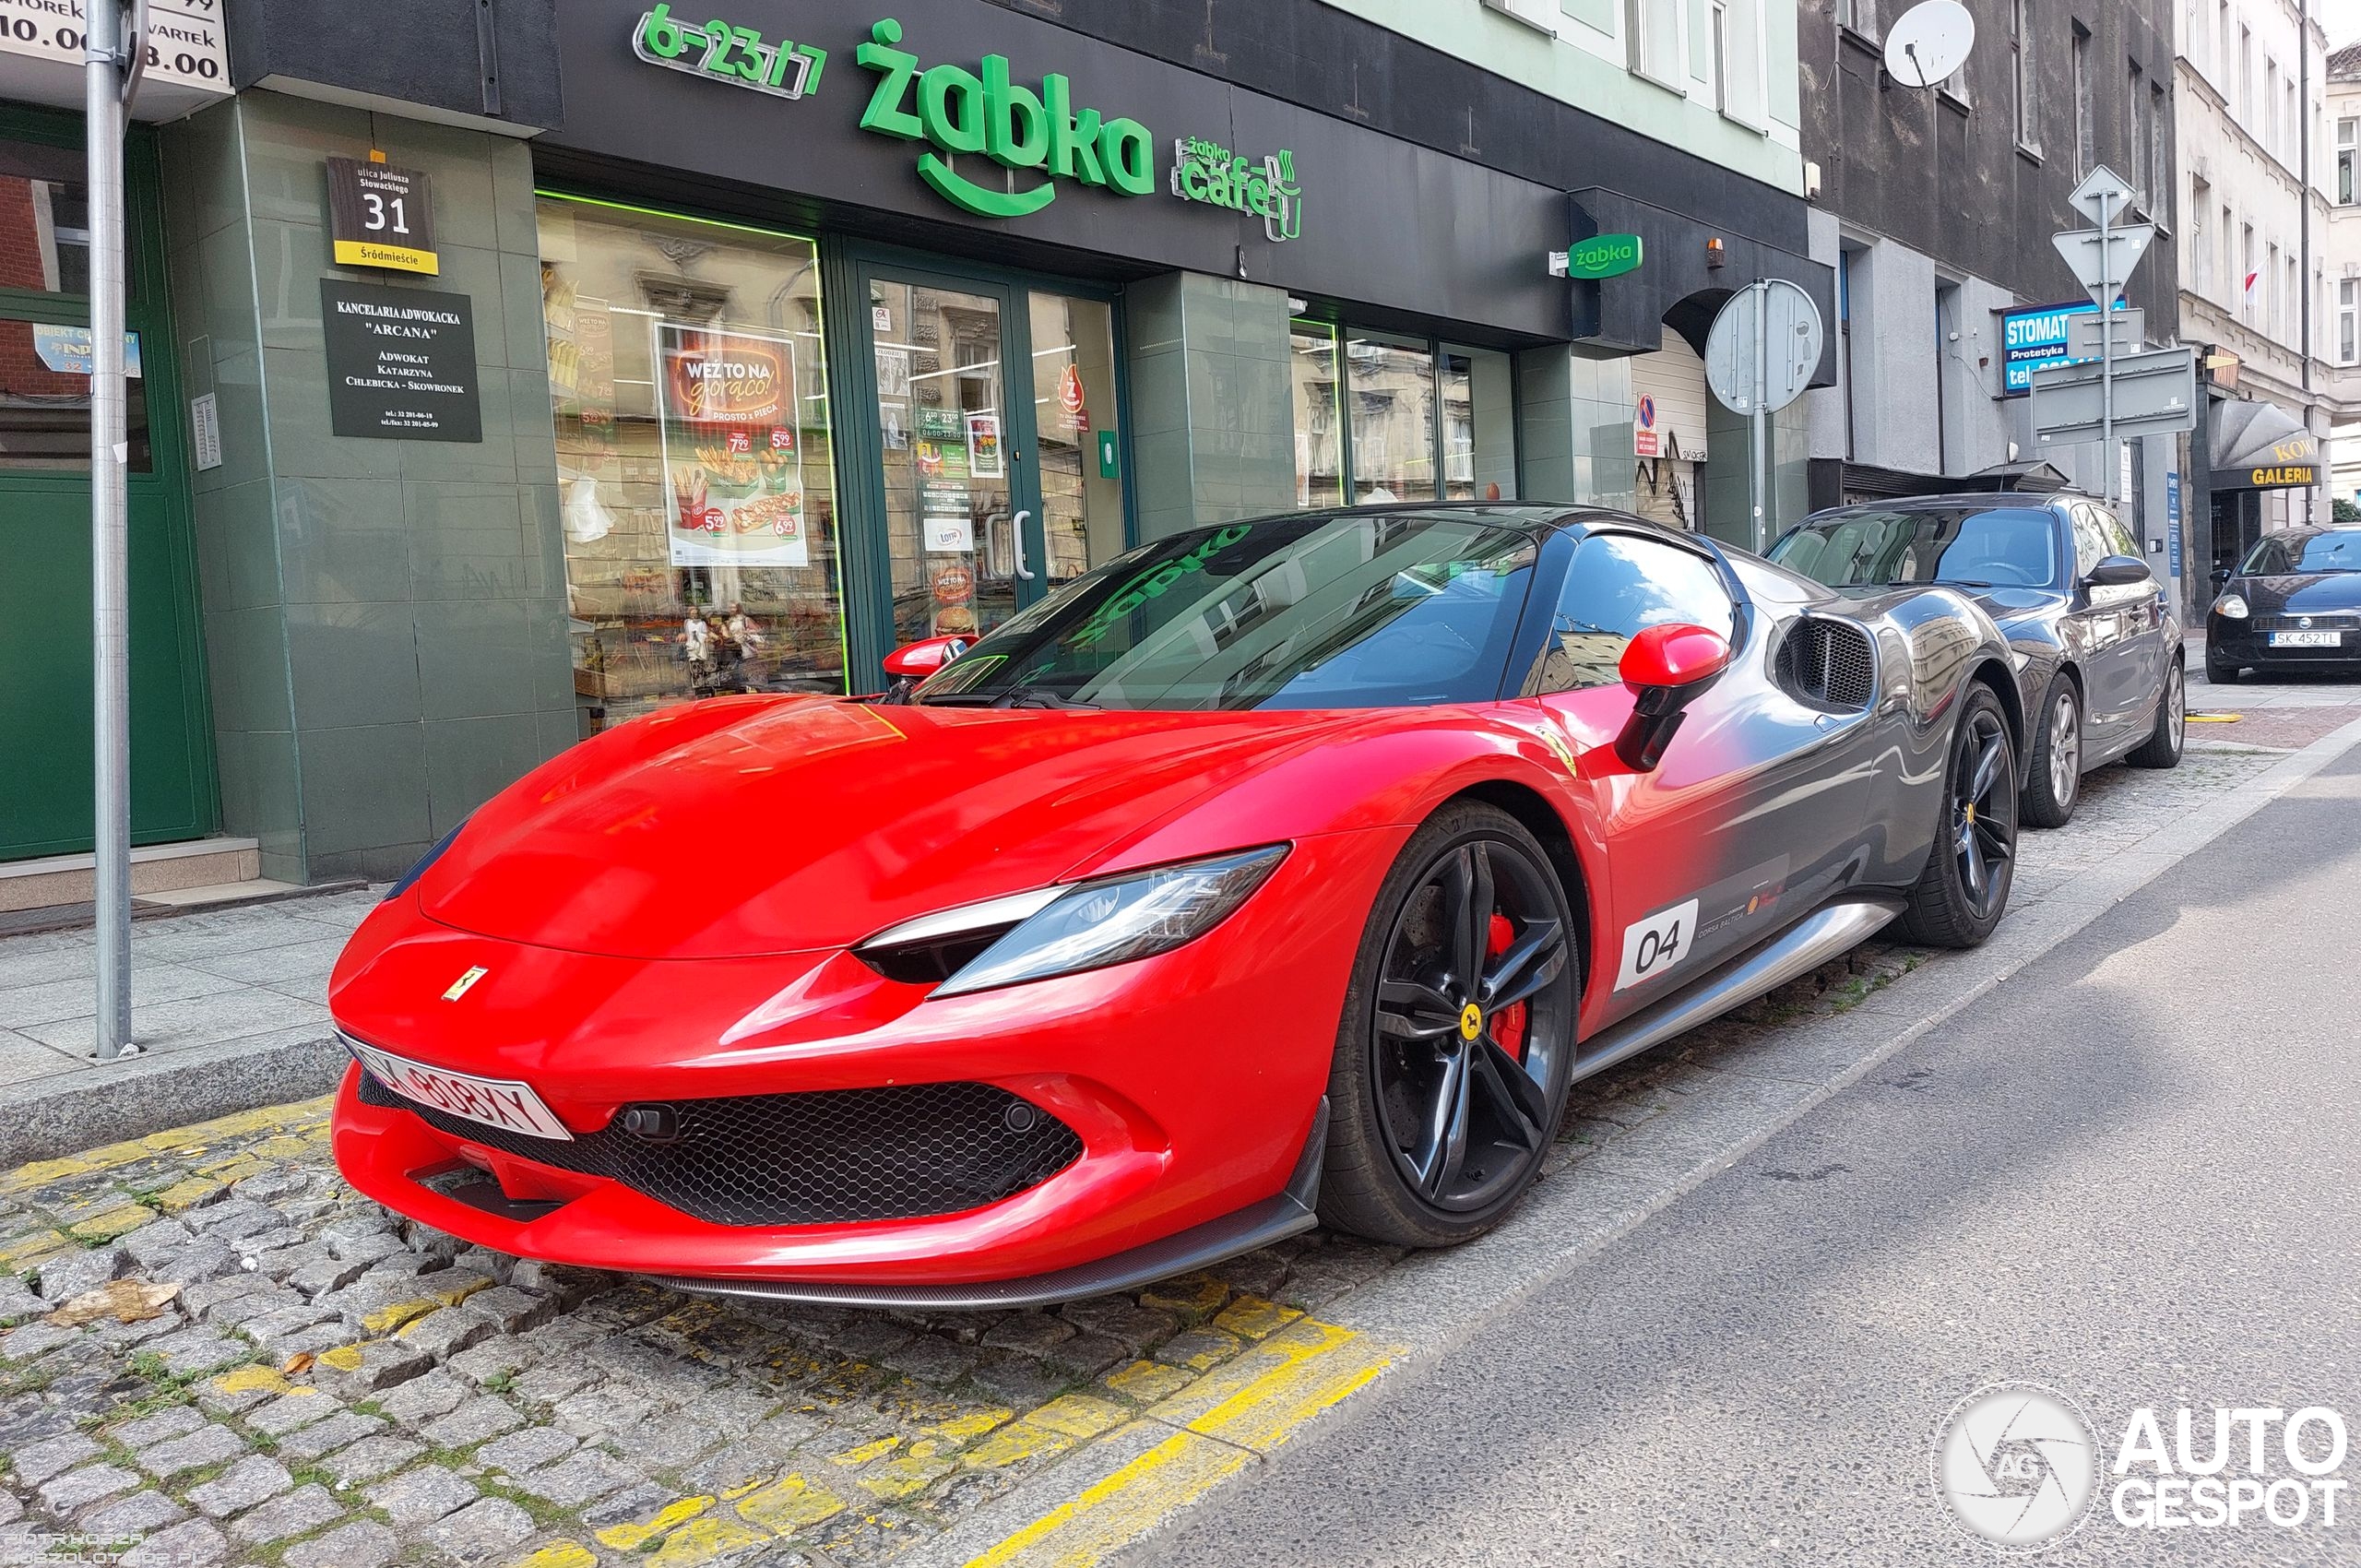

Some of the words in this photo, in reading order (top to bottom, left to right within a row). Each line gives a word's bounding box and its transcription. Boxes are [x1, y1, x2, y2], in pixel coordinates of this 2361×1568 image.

[647, 3, 828, 96] 6-23/7
[856, 18, 1155, 196] żabka
[1188, 136, 1230, 162] żabka
[358, 168, 378, 178] ulica
[380, 171, 409, 184] Juliusza
[360, 179, 409, 194] Słowackiego
[363, 194, 409, 234] 31
[361, 246, 419, 265] Śródmieście
[1576, 244, 1631, 267] żabka
[337, 301, 400, 319] KANCELARIA
[400, 308, 461, 326] ADWOKACKA
[36, 326, 74, 338] OBIEKT
[365, 322, 437, 339] "ARCANA"
[2007, 315, 2069, 345] STOMAT
[378, 350, 429, 364] ADWOKAT
[2011, 346, 2064, 361] Protetyka
[376, 364, 433, 378] KATARZYNA
[686, 360, 722, 379] WEŹ
[723, 362, 744, 379] TO
[749, 363, 770, 379] NA
[345, 376, 400, 389] CHLEBICKA
[408, 381, 465, 394] SKOWRONEK
[690, 370, 776, 416] gorąco!
[713, 411, 747, 422] PROSTO
[754, 404, 778, 419] PIECA
[2251, 468, 2313, 485] GALERIA
[2277, 633, 2293, 644] SK
[2298, 633, 2336, 644] 452TL
[1635, 920, 1680, 975] 04
